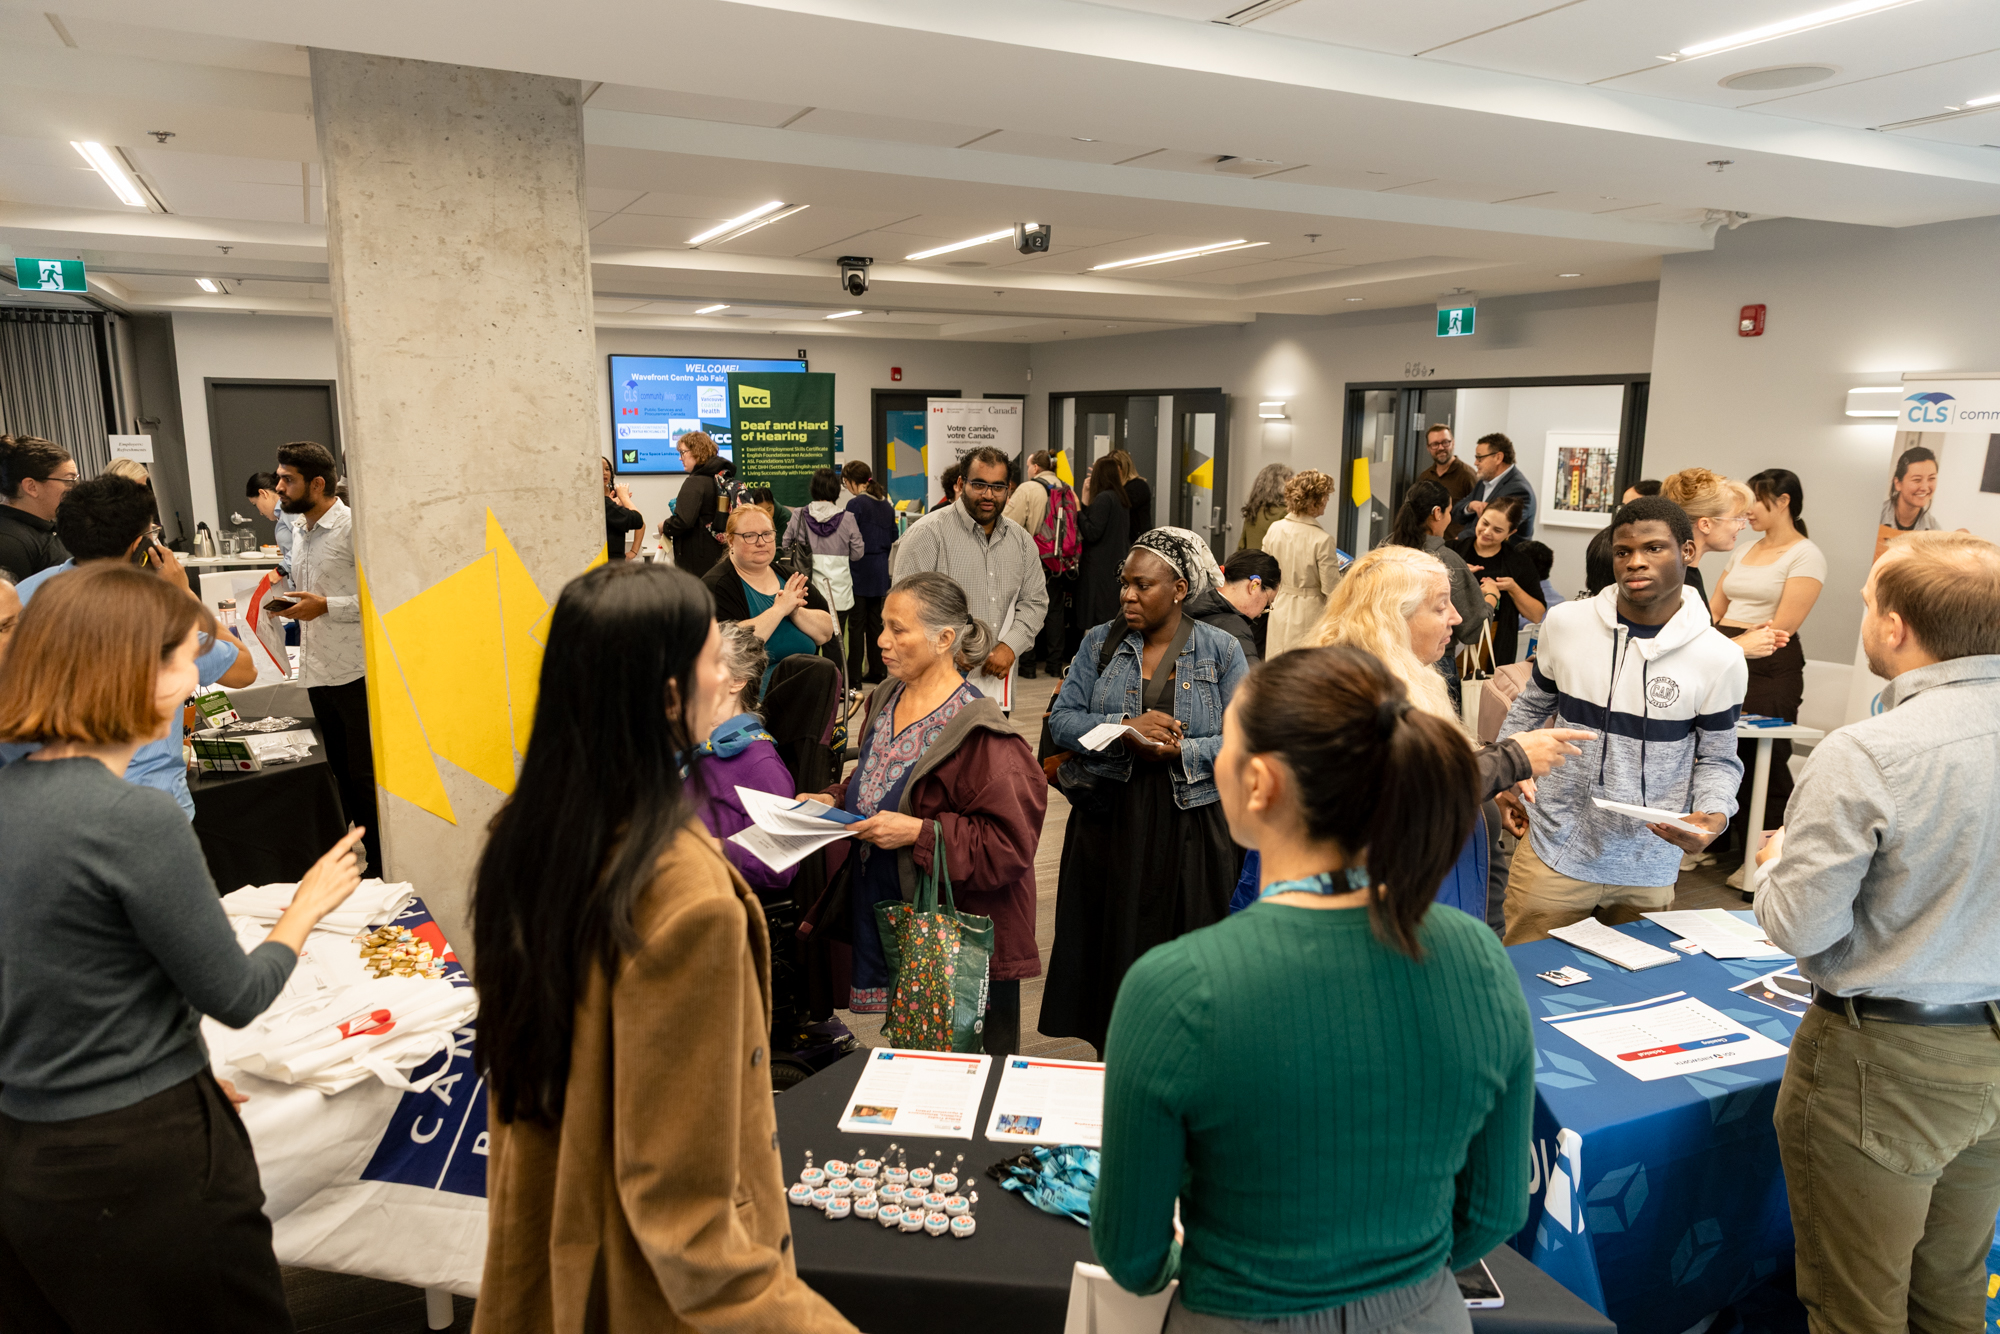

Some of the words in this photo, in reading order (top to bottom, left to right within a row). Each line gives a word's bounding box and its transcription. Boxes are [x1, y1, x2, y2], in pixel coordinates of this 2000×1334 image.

[1035, 237, 1042, 246] 2
[685, 364, 739, 373] WELCOME!
[631, 373, 669, 381] Wavefront
[670, 374, 694, 382] Centre
[695, 374, 709, 382] Job
[710, 375, 726, 383] Fair,
[624, 390, 638, 402] CLS
[742, 396, 768, 405] VCC
[988, 406, 1017, 414] Canada
[1908, 406, 1949, 423] CLS
[1960, 411, 2000, 420] comm
[740, 421, 771, 430] Deaf
[773, 421, 796, 430] and
[798, 421, 829, 430] Hard
[969, 425, 998, 433] carrière,
[741, 431, 754, 441] of
[756, 431, 808, 443] Hearing
